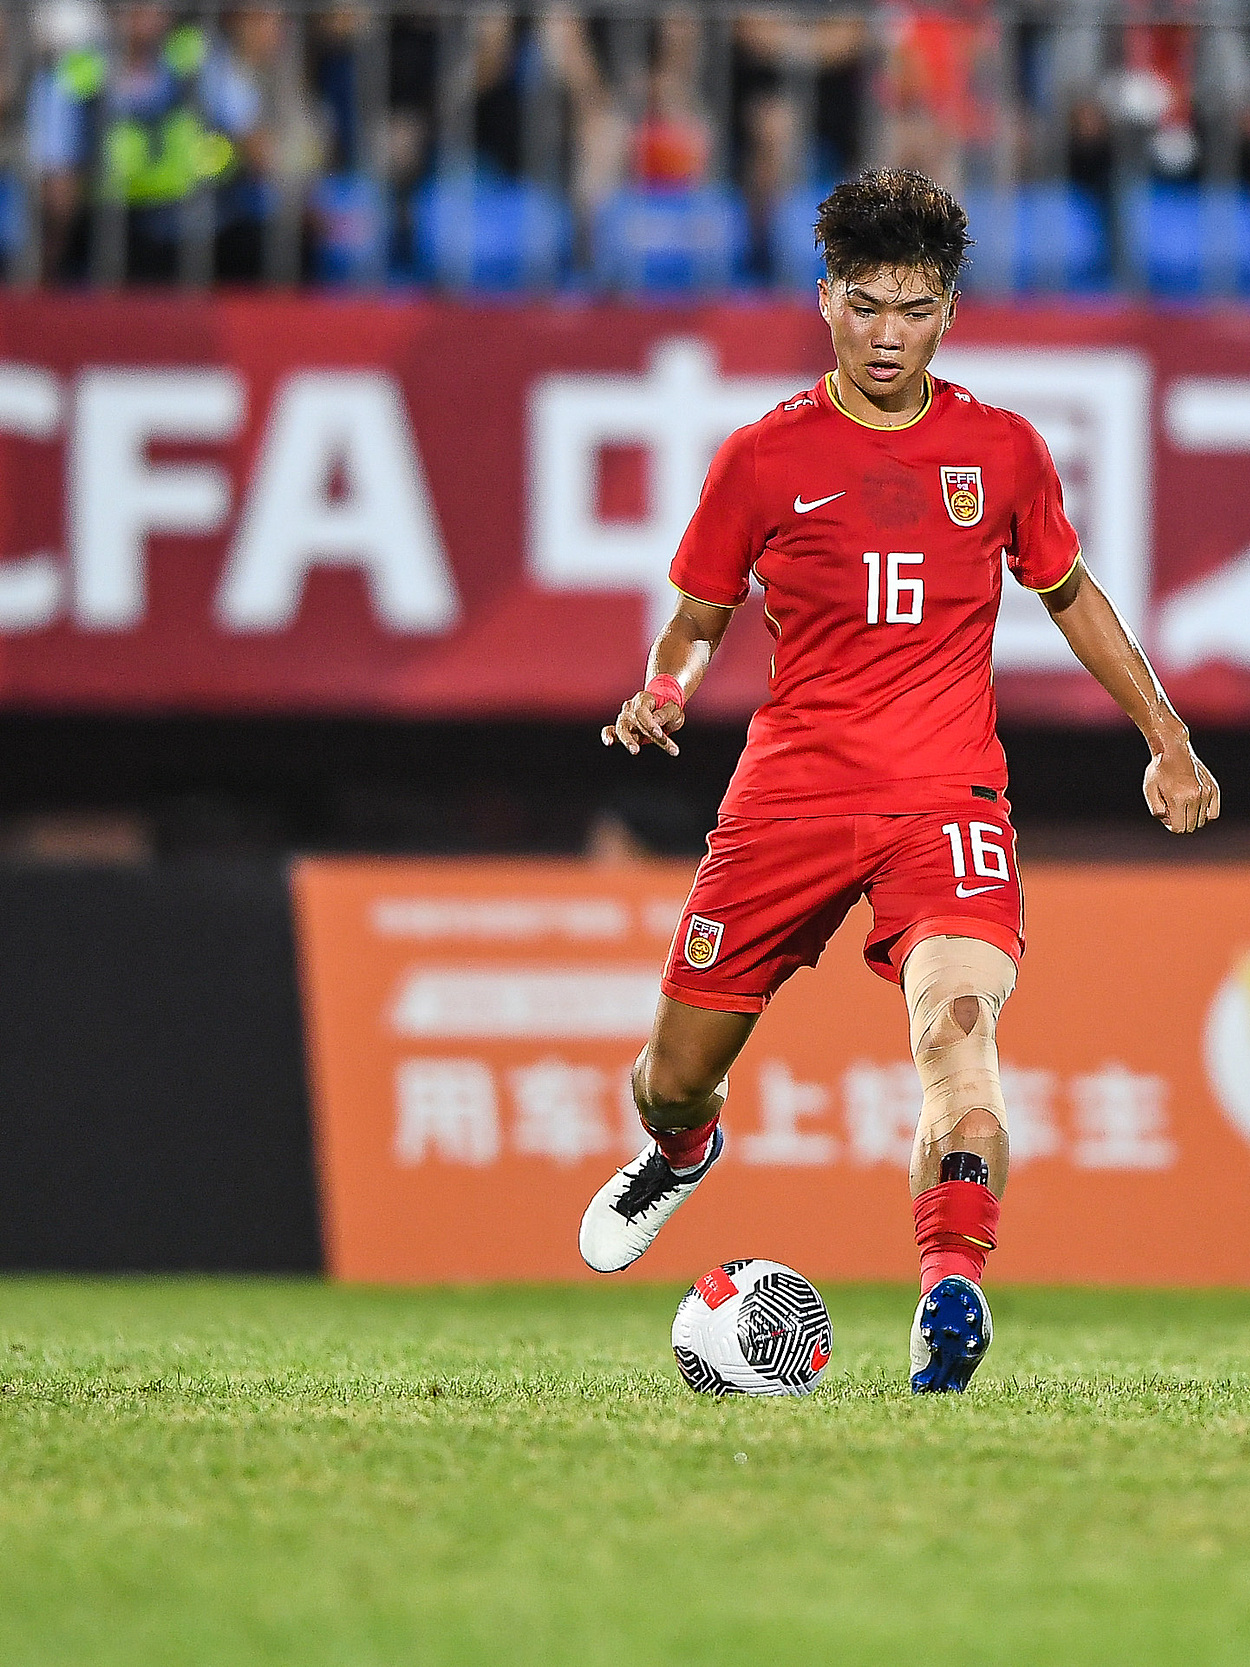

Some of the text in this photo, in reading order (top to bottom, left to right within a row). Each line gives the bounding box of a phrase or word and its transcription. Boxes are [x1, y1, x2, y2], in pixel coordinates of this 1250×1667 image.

[946, 473, 976, 484] CFA
[863, 552, 924, 625] 16
[942, 821, 1010, 882] 16
[694, 921, 719, 936] CFA
